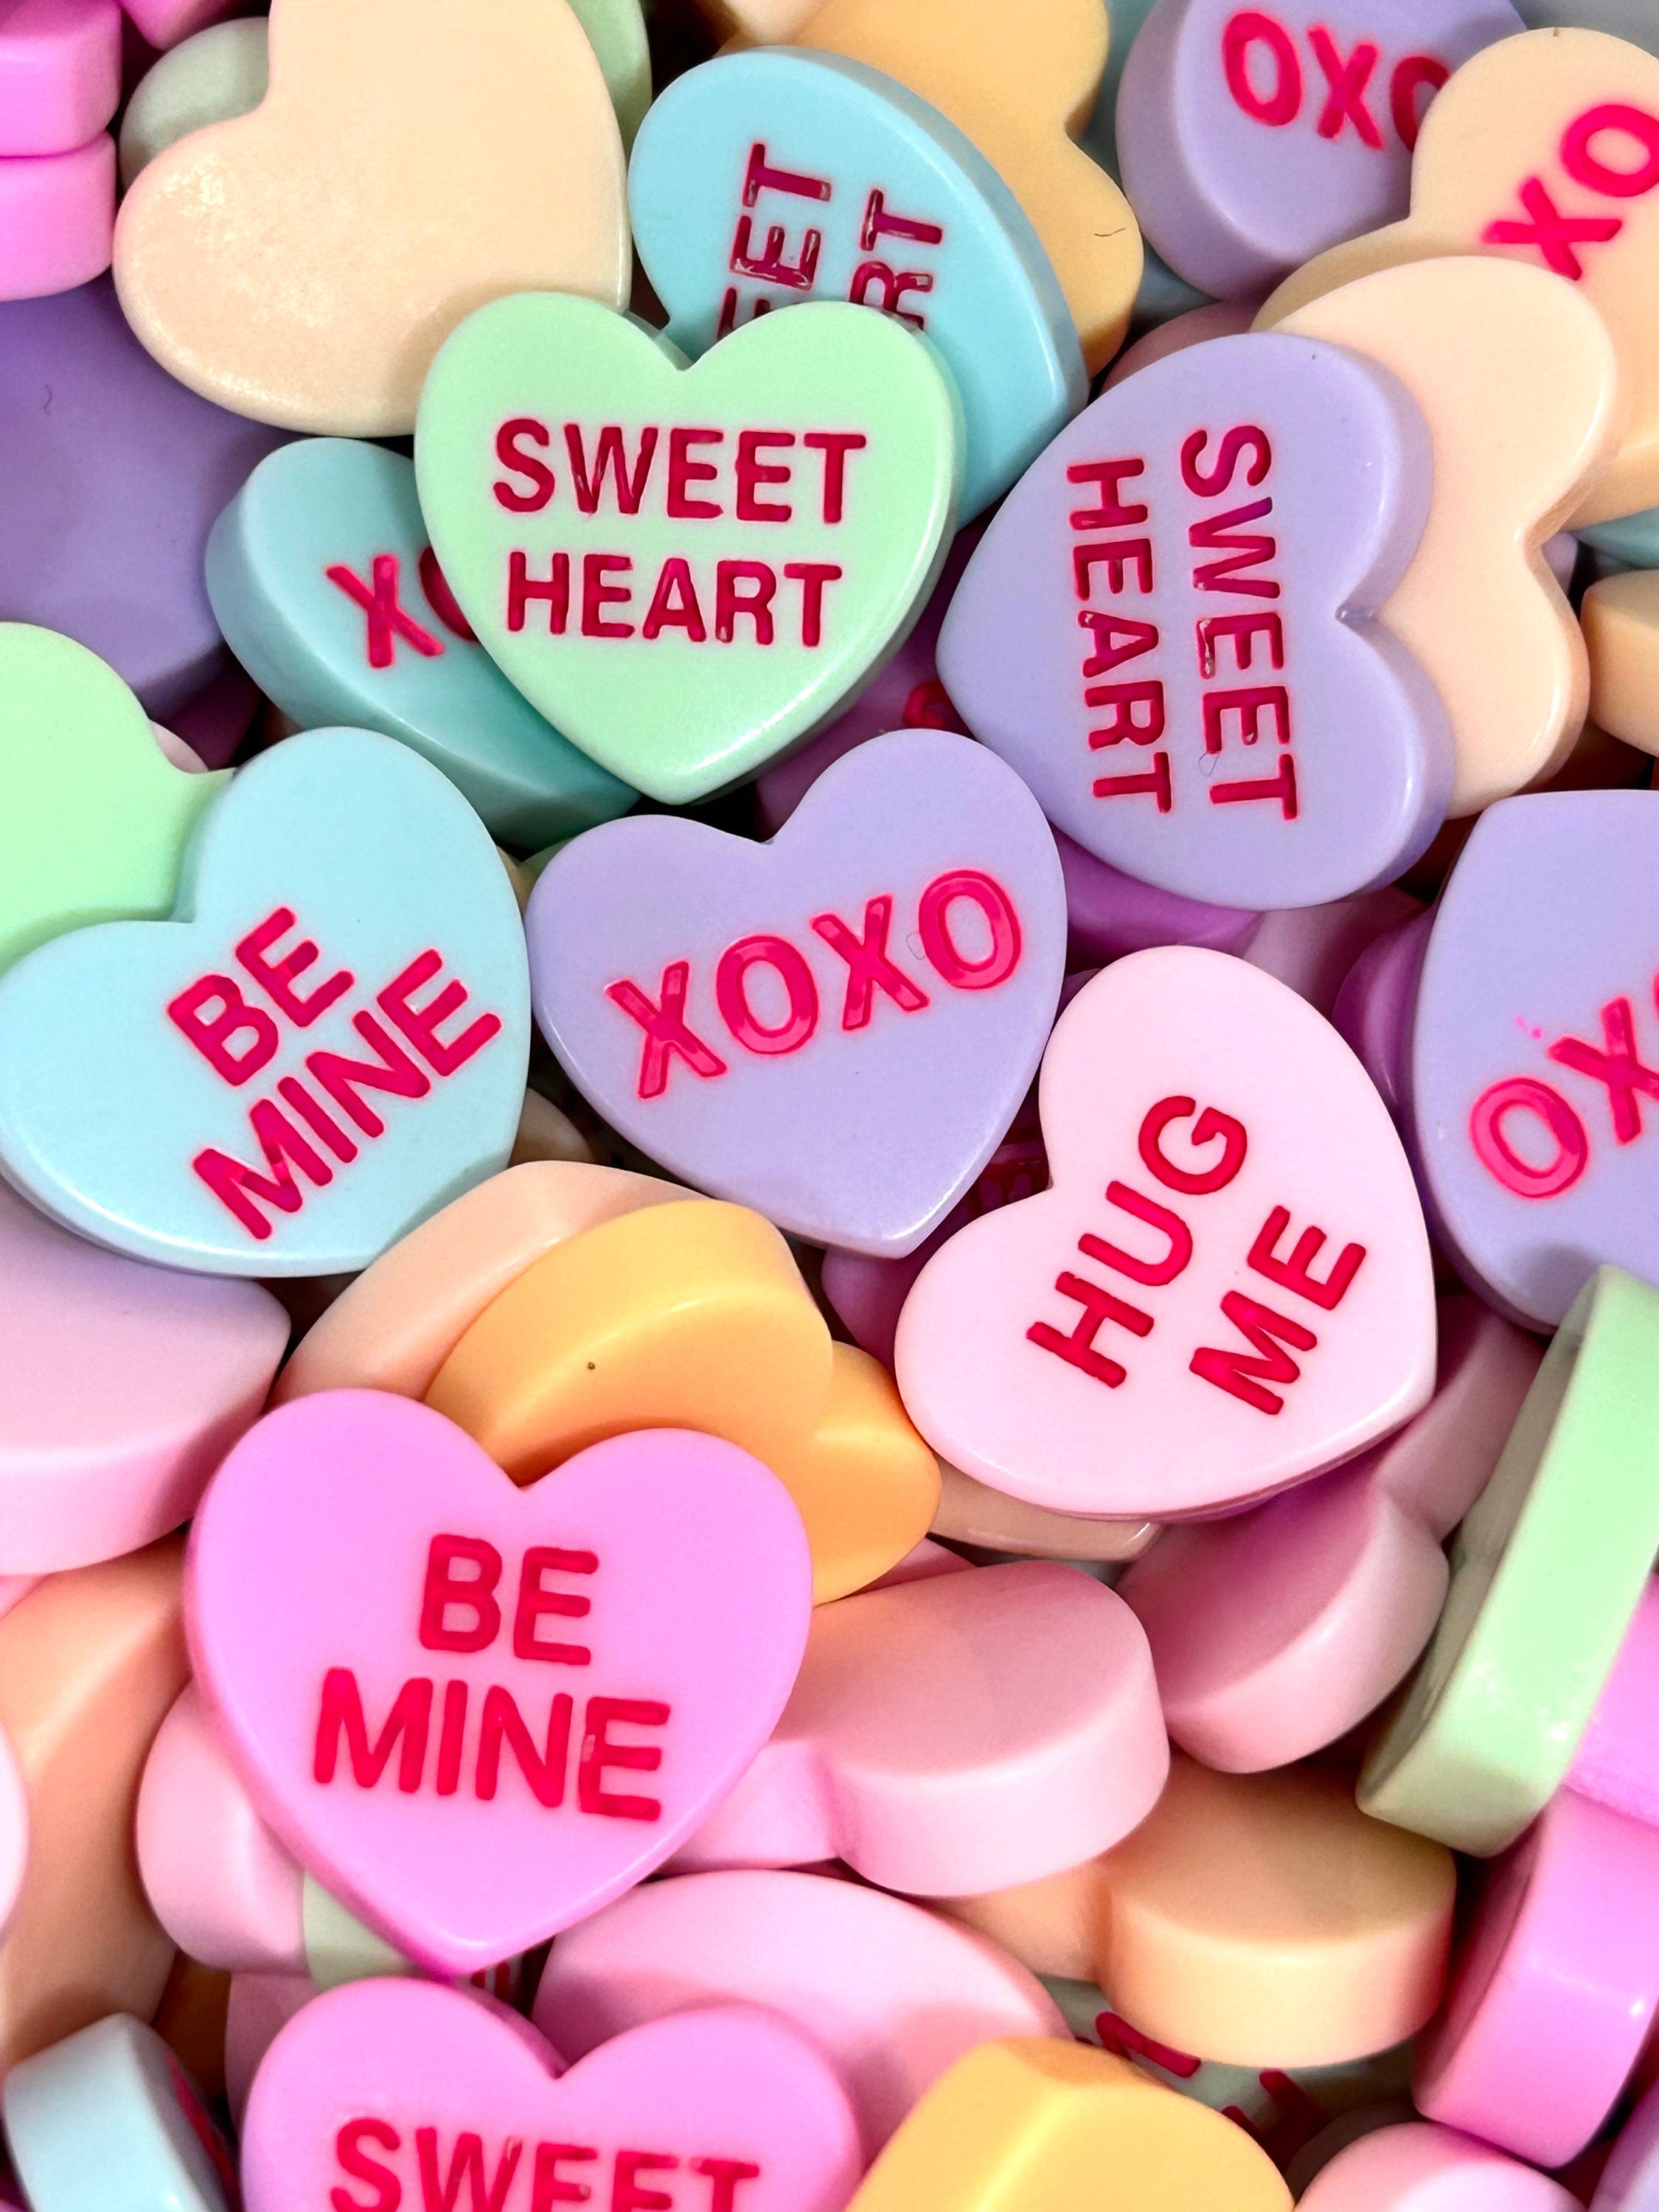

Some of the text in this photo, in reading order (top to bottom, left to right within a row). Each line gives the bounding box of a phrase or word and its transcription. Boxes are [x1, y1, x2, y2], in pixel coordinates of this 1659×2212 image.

[1481, 102, 1659, 282] XO
[492, 417, 866, 523] SWEET
[507, 551, 842, 647] HEART
[1066, 458, 1172, 814] HEART
[1180, 425, 1298, 821] SWEET
[167, 906, 354, 1087] BE
[605, 869, 1023, 1099] XOXO
[192, 949, 501, 1240] MINE
[1469, 970, 1659, 1200] OX
[1026, 1095, 1248, 1389] HUG
[1189, 1205, 1367, 1416] ME
[417, 1531, 600, 1666] BE
[312, 1666, 672, 1823] MINE
[329, 2116, 761, 2212] SWEET
